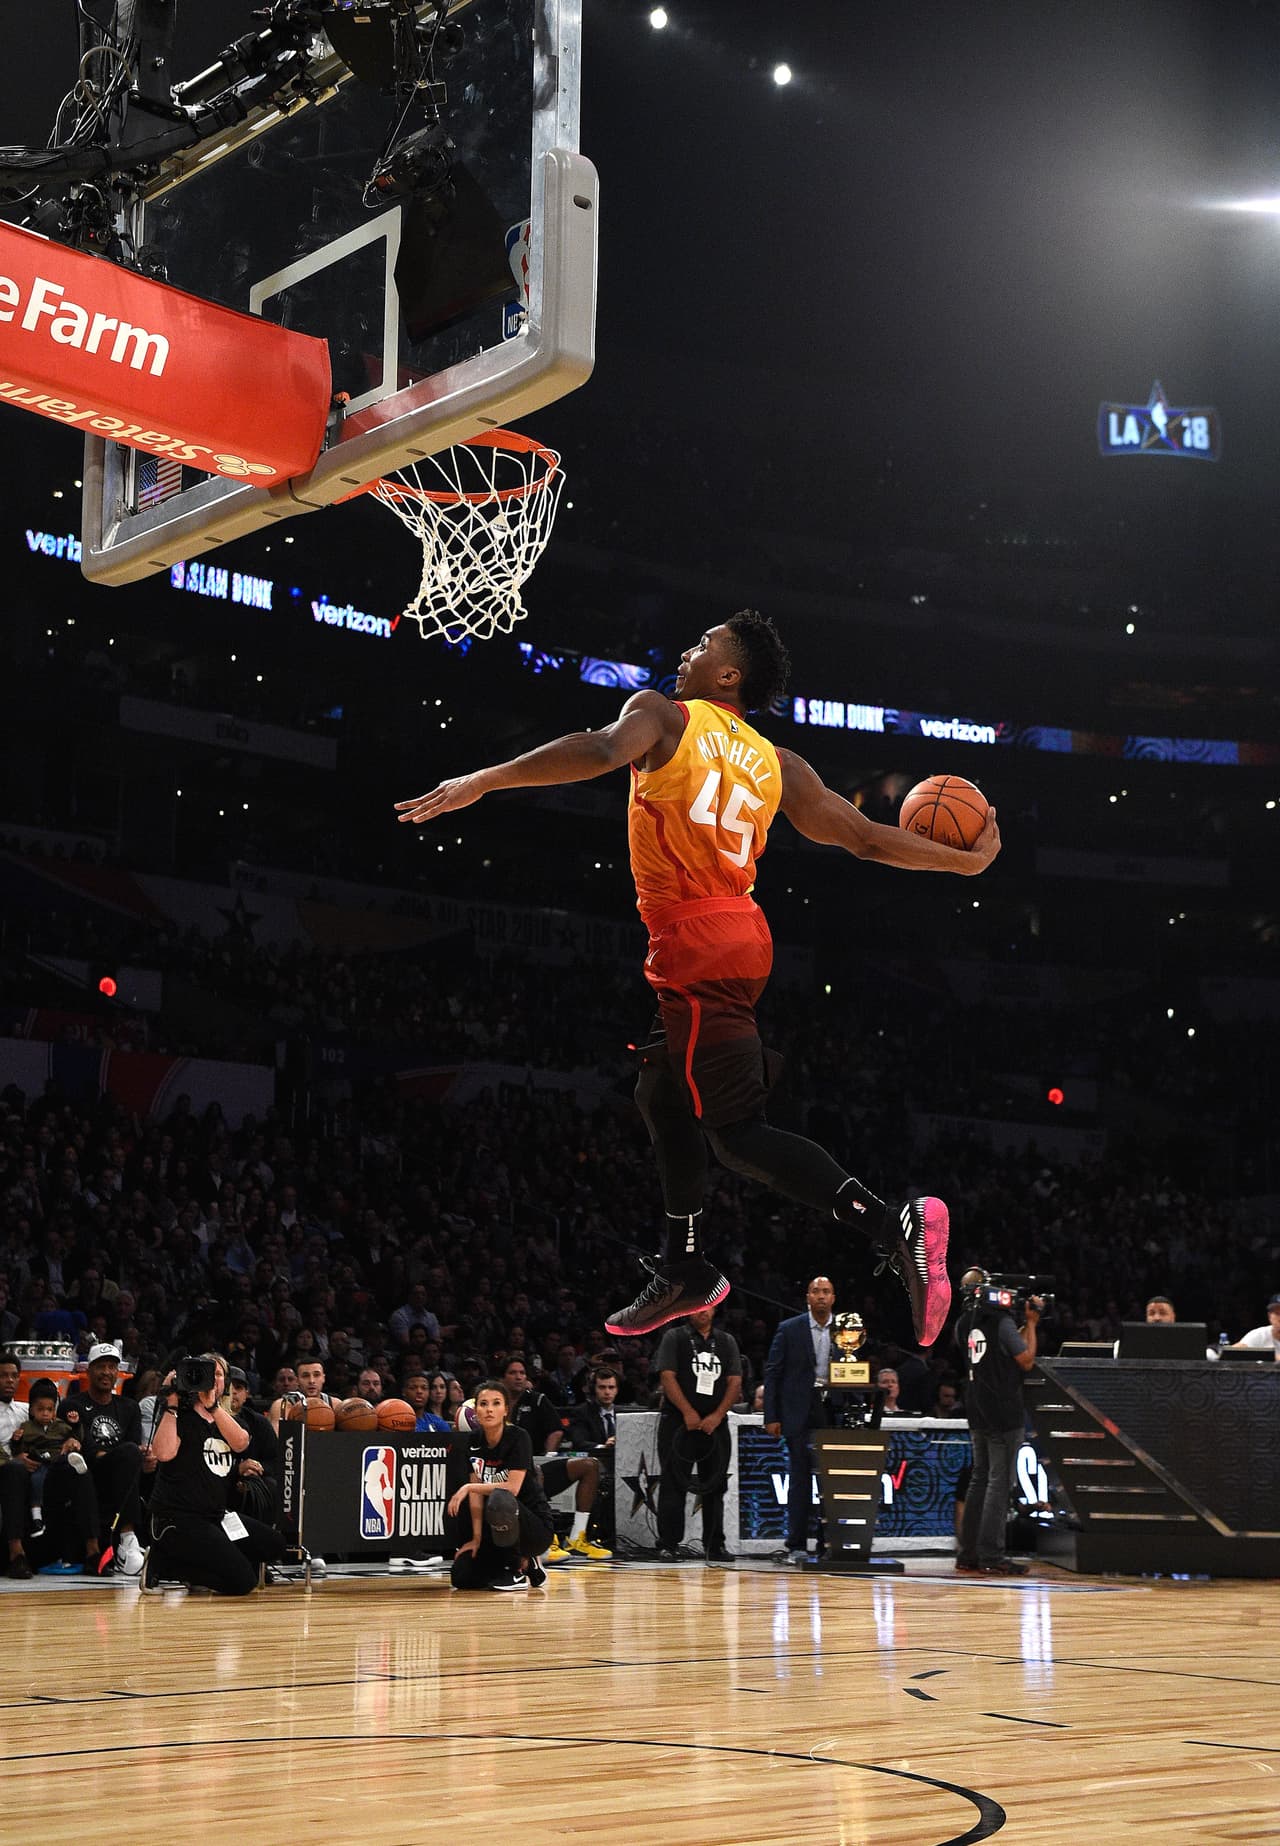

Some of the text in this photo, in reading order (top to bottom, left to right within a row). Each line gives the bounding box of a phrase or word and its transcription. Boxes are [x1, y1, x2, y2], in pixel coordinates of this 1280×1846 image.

[1109, 412, 1210, 450] LA 18
[185, 562, 273, 611] SLAM DUNK
[311, 600, 392, 638] verizon
[808, 700, 885, 733] SLAM DUNK
[920, 718, 996, 744] verizon
[696, 731, 773, 784] MITCHELL
[688, 769, 766, 868] 45
[691, 1361, 720, 1374] TNT
[401, 1445, 447, 1459] verizon
[283, 1436, 294, 1513] verizon
[400, 1463, 447, 1500] SLAM
[365, 1518, 382, 1533] NBA
[399, 1502, 446, 1537] DUNK
